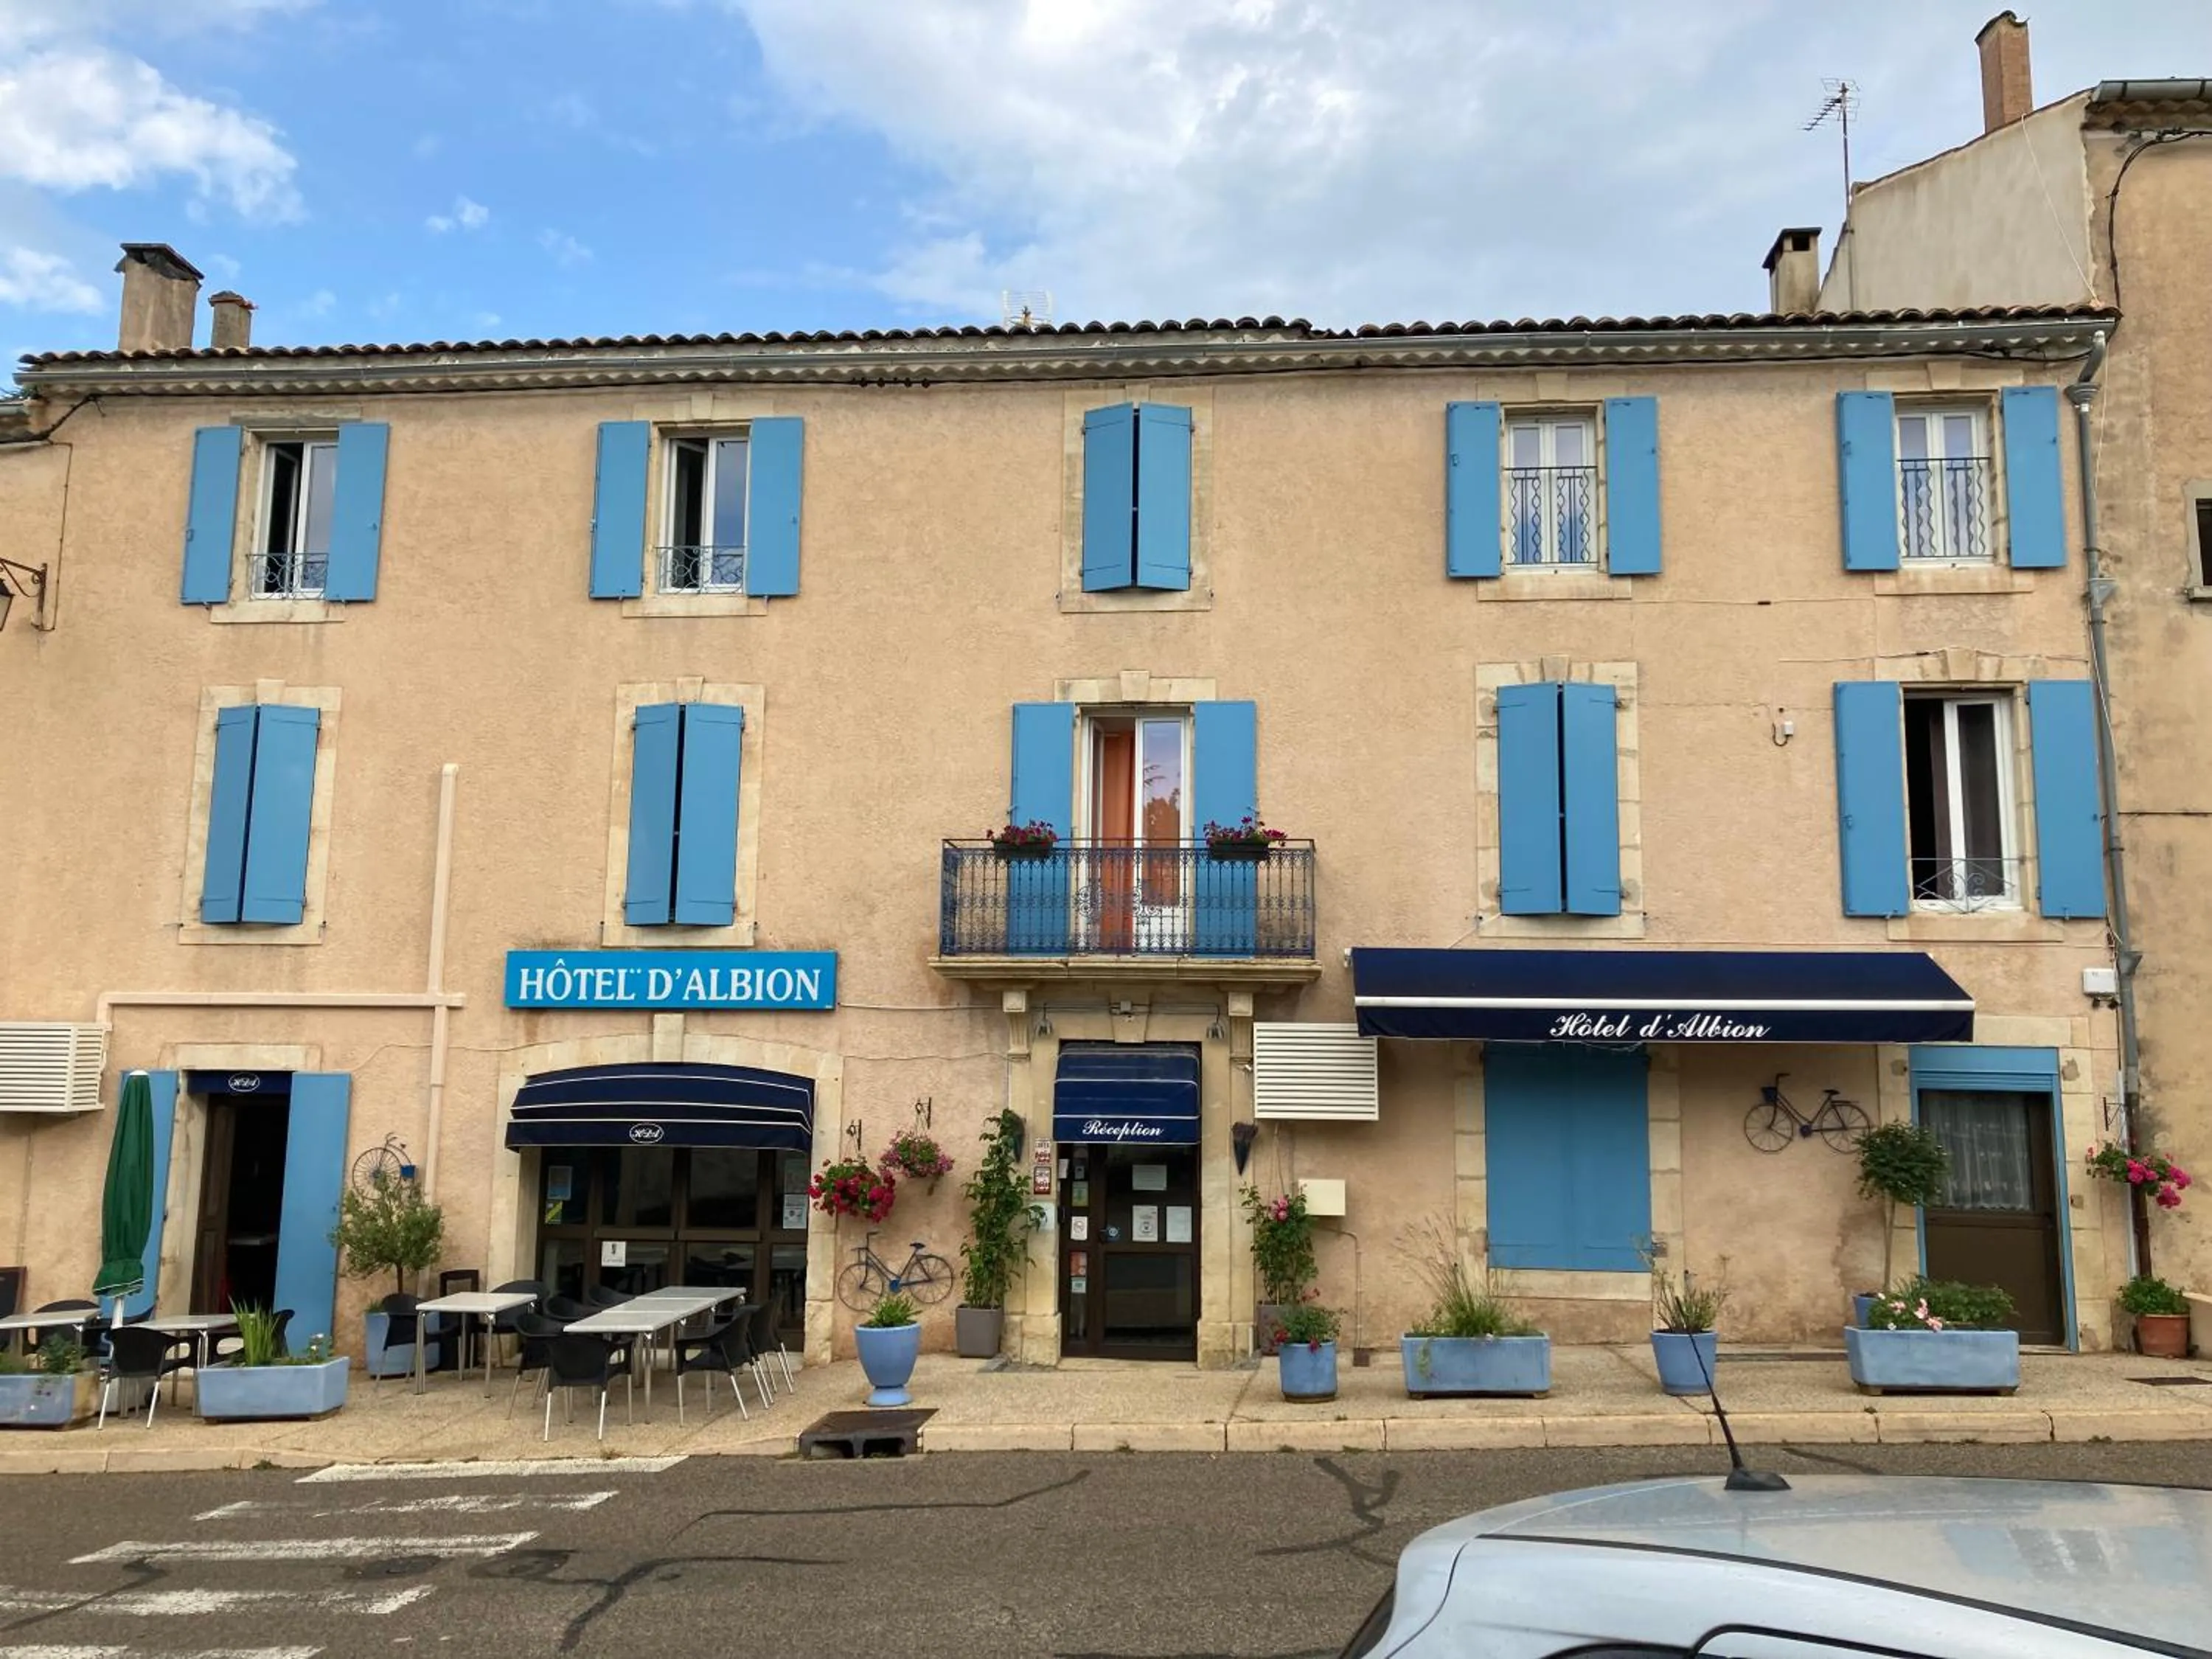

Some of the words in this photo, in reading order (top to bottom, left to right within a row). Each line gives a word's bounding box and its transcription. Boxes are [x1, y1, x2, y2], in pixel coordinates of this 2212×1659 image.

[519, 958, 636, 1001] HÔTEL
[647, 967, 821, 1001] D'ALBION
[1549, 1012, 1632, 1038] Hôtel
[1638, 1013, 1771, 1038] d'Albion
[1082, 1119, 1165, 1141] Réception
